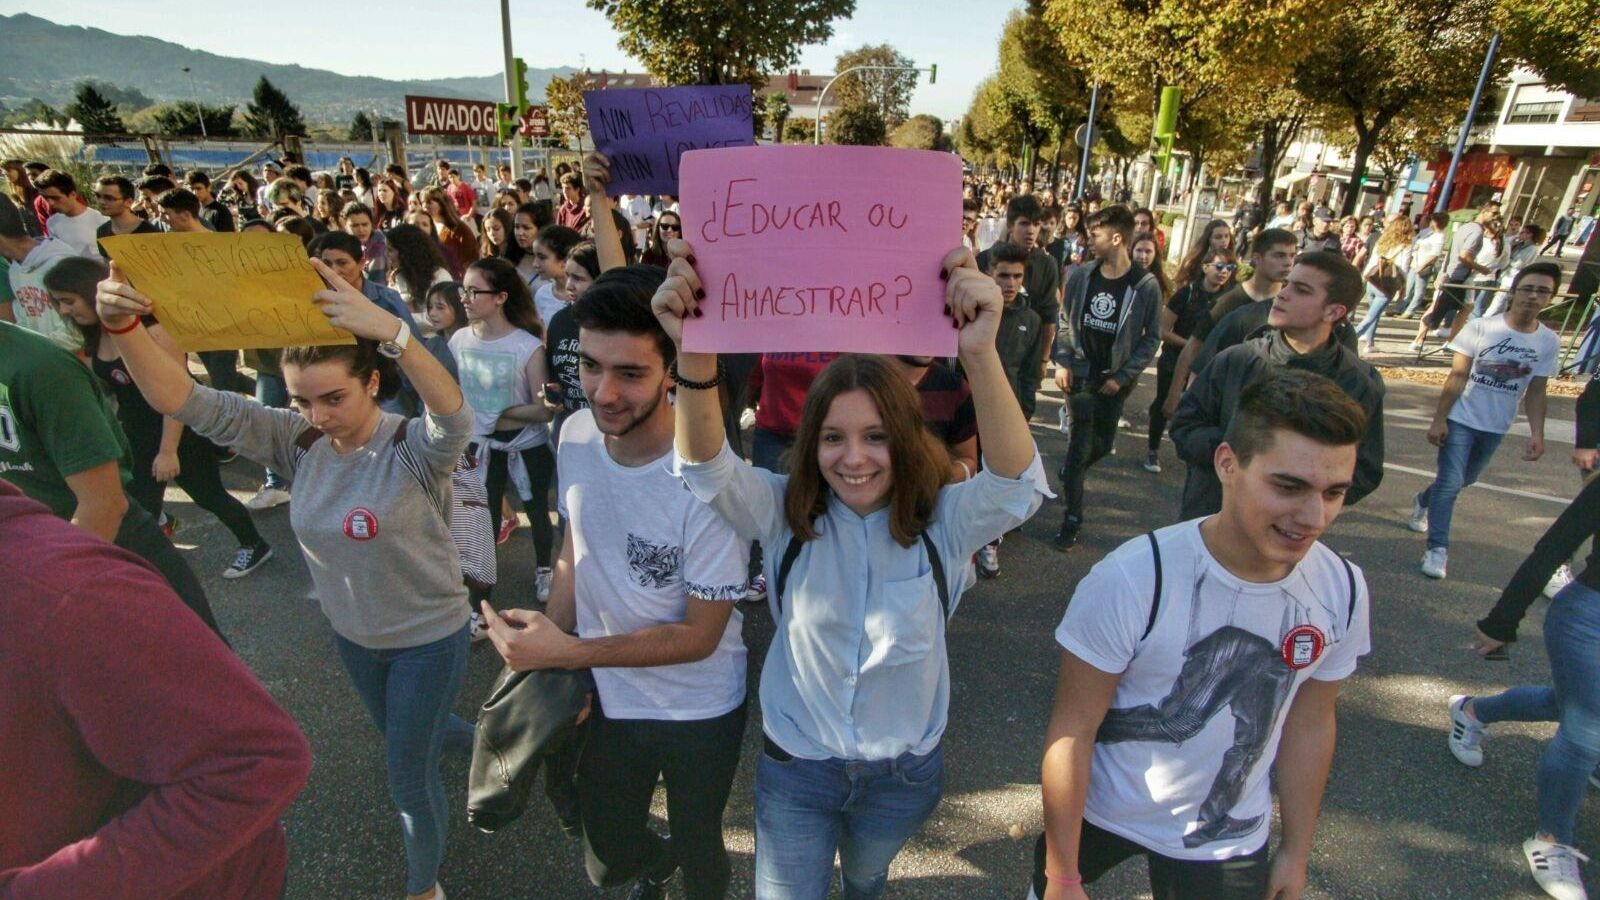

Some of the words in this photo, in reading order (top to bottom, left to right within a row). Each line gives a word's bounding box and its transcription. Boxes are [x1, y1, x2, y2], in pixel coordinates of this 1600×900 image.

[598, 105, 636, 143] NIN
[645, 90, 751, 133] REVALIDAS
[612, 152, 654, 182] NIN
[701, 178, 848, 243] ¿EDUCAR
[868, 203, 908, 229] OU
[721, 272, 913, 325] AMAESTRAR?
